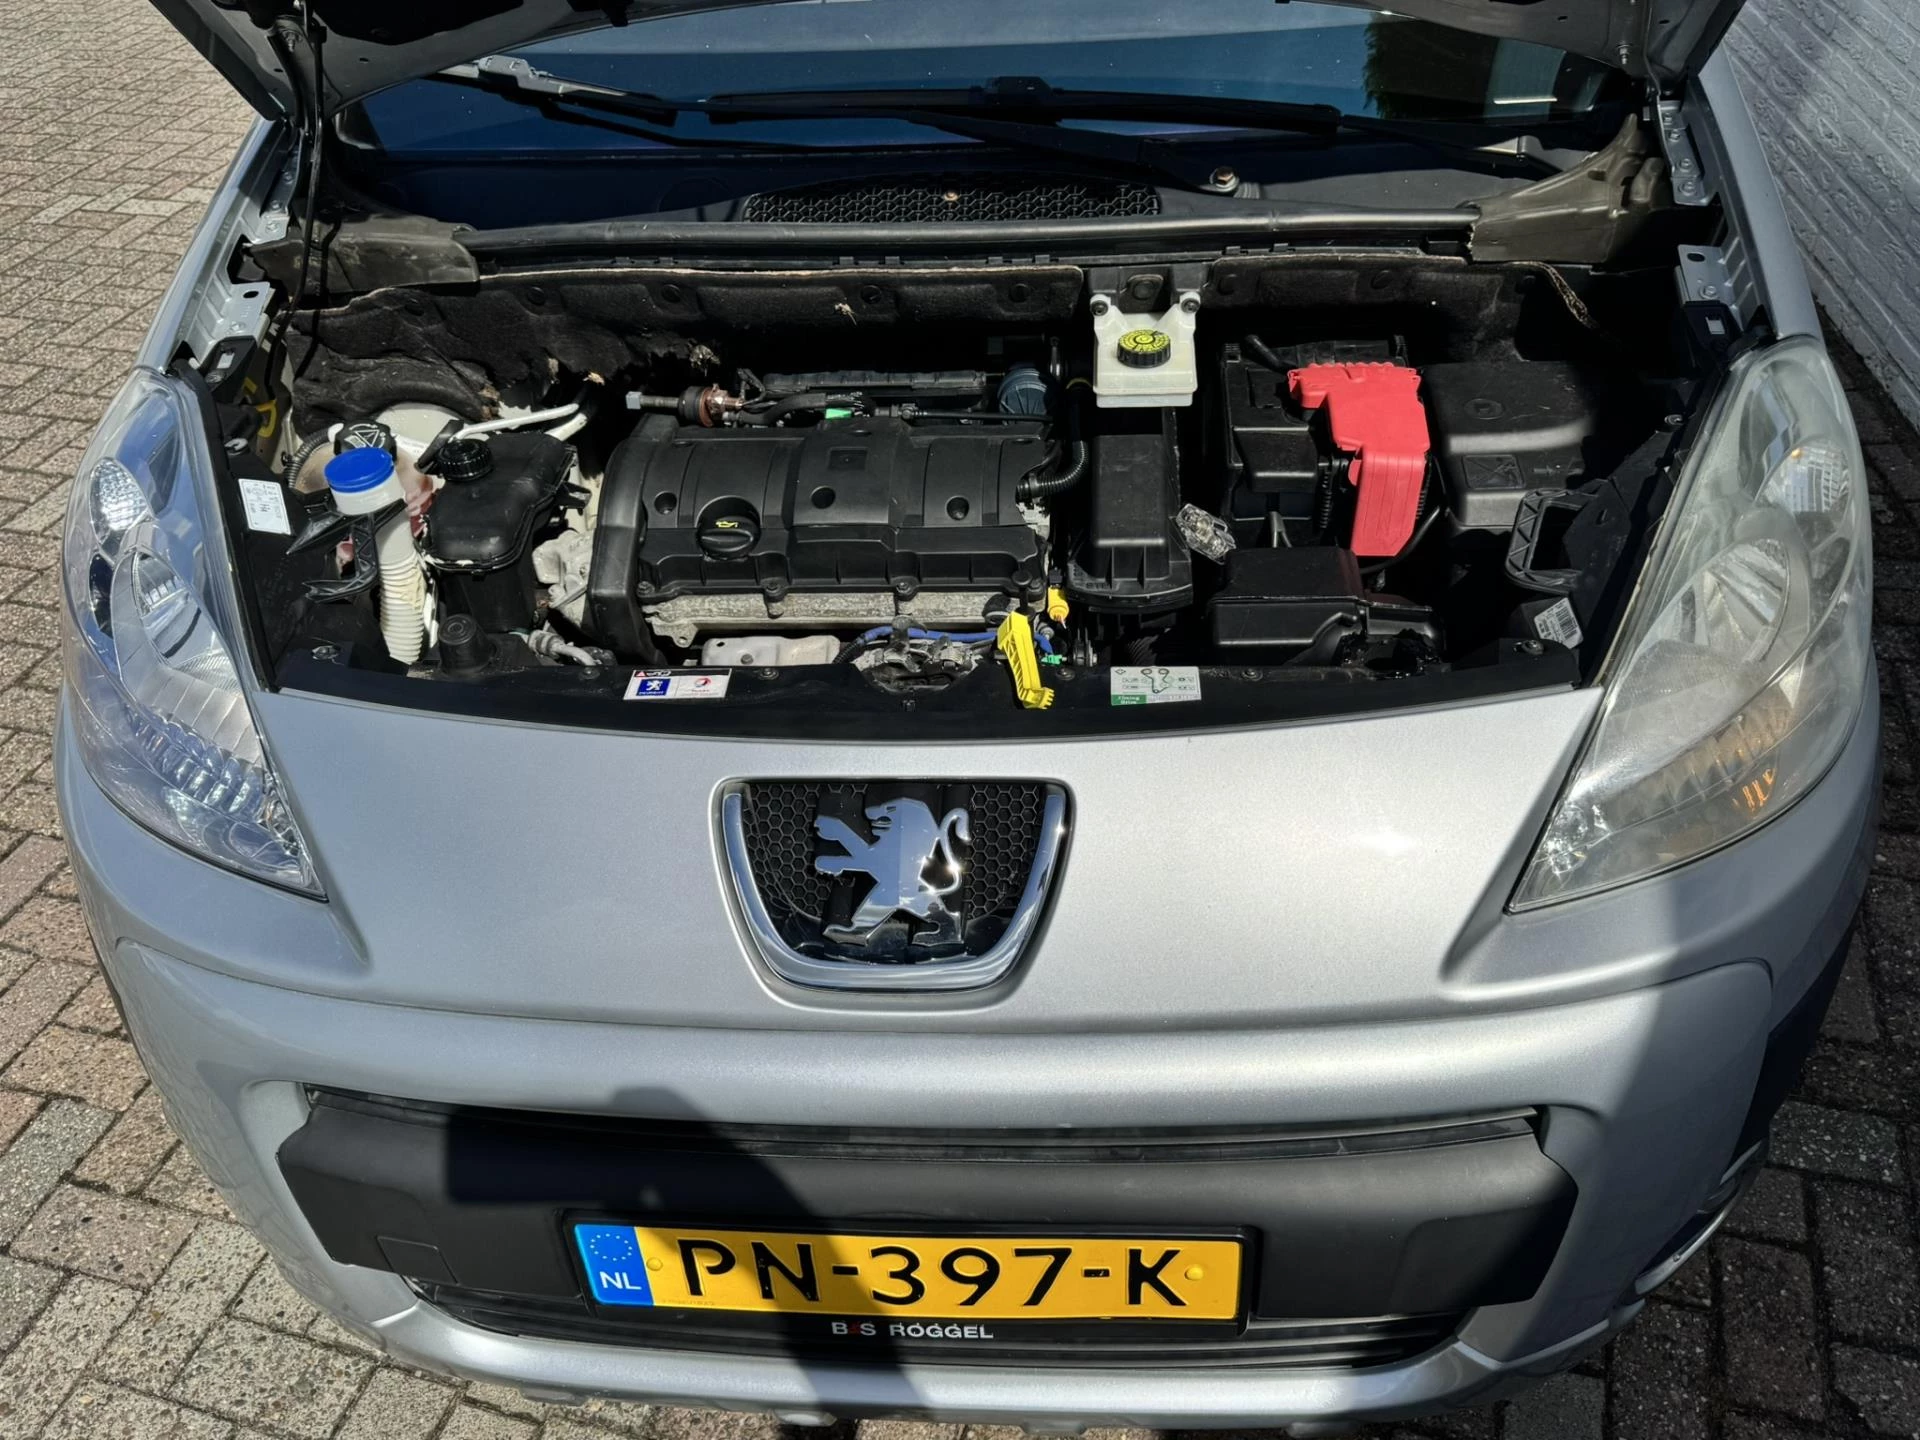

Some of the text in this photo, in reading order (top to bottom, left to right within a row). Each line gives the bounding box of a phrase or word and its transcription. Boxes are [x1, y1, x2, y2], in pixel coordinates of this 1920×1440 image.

[600, 1271, 642, 1290] NL
[677, 1239, 1187, 1306] PN-397-K
[889, 1323, 994, 1339] ROGGEL
